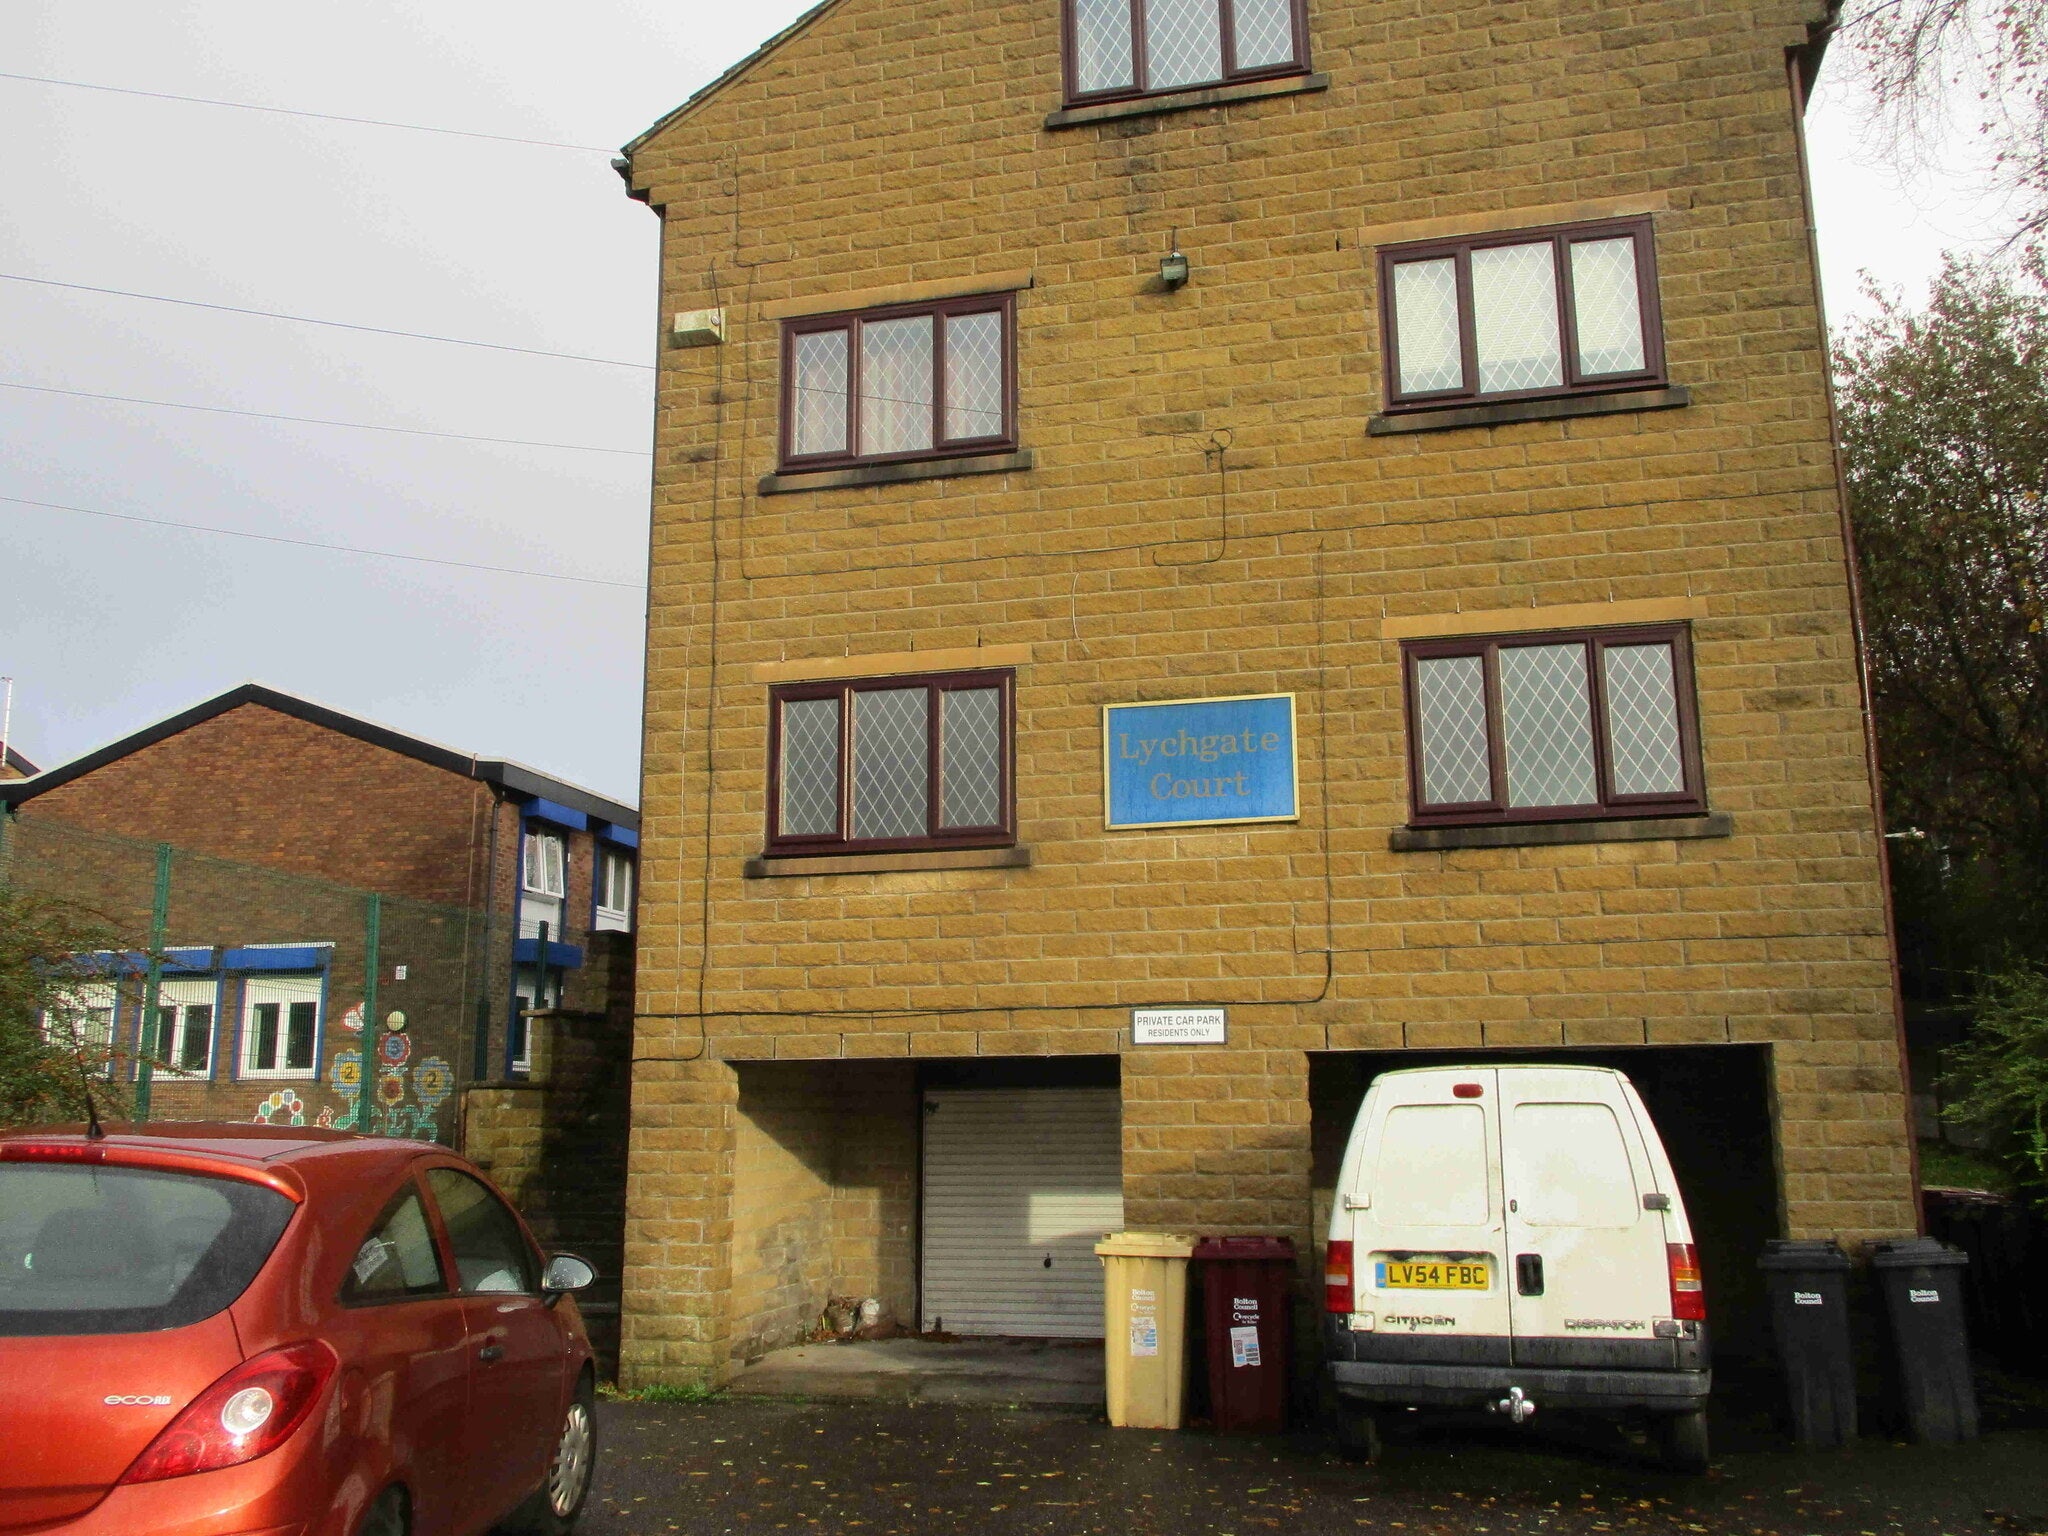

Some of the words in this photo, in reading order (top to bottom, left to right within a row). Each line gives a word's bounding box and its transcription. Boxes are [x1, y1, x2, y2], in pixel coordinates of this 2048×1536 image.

[1118, 727, 1280, 766] Lychgate
[1150, 770, 1252, 801] Court
[1137, 1016, 1173, 1026] PRIVATE
[1175, 1016, 1195, 1026] CAR
[1197, 1015, 1221, 1025] PARK
[1148, 1029, 1189, 1037] RESIDENTS
[1191, 1028, 1210, 1037] ONLY
[344, 1066, 355, 1080] 2
[427, 1072, 437, 1089] 2
[1388, 1265, 1440, 1284] LV54
[1446, 1265, 1485, 1285] FBC
[1233, 1297, 1258, 1305] Bolton
[1793, 1291, 1821, 1299] Bolton
